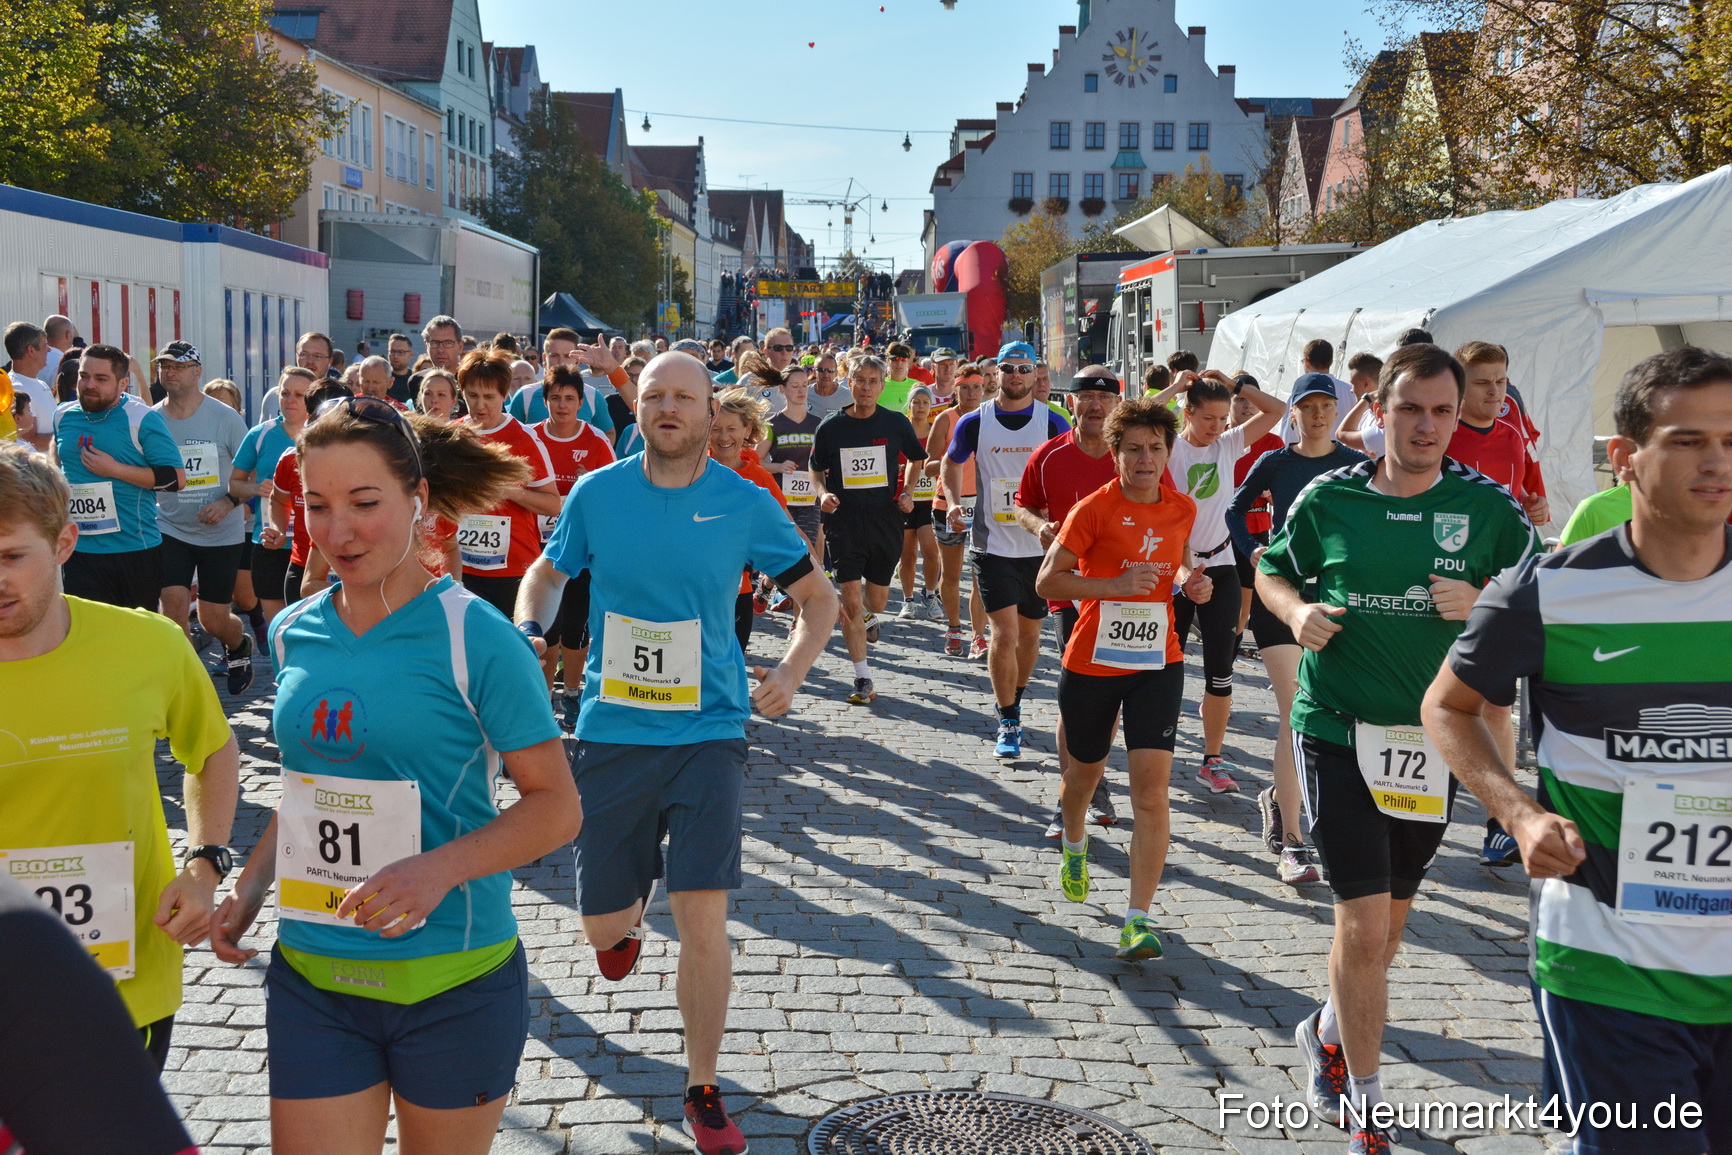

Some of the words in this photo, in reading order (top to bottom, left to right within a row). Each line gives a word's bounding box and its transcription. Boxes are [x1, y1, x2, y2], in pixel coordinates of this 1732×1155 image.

[790, 284, 824, 293] START
[185, 458, 202, 471] 47
[852, 458, 875, 471] 337
[791, 480, 810, 491] 287
[70, 497, 106, 514] 2084
[1386, 510, 1422, 521] hummel
[1442, 525, 1451, 536] F
[459, 530, 500, 548] 2243
[1452, 534, 1461, 546] C
[467, 555, 490, 565] Angela
[1434, 557, 1466, 572] PDU
[1121, 608, 1151, 616] BOCK
[632, 626, 672, 640] BOCK
[1109, 621, 1158, 641] 3048
[634, 645, 663, 674] 51
[623, 673, 641, 681] PARTL
[629, 686, 672, 701] Markus
[30, 734, 66, 745] Kliniken
[86, 727, 128, 738] Landkreises
[1386, 730, 1424, 743] BOCK
[59, 740, 102, 751] Neumarkt
[1380, 748, 1426, 780] 172
[315, 788, 373, 810] BOCK
[1384, 795, 1416, 811] Phillip
[318, 820, 362, 866] 81
[1645, 821, 1732, 867] 212
[9, 856, 85, 874] BOCK
[307, 866, 332, 879] PARTL
[1654, 870, 1688, 881] PARTL
[331, 961, 385, 980] FORM
